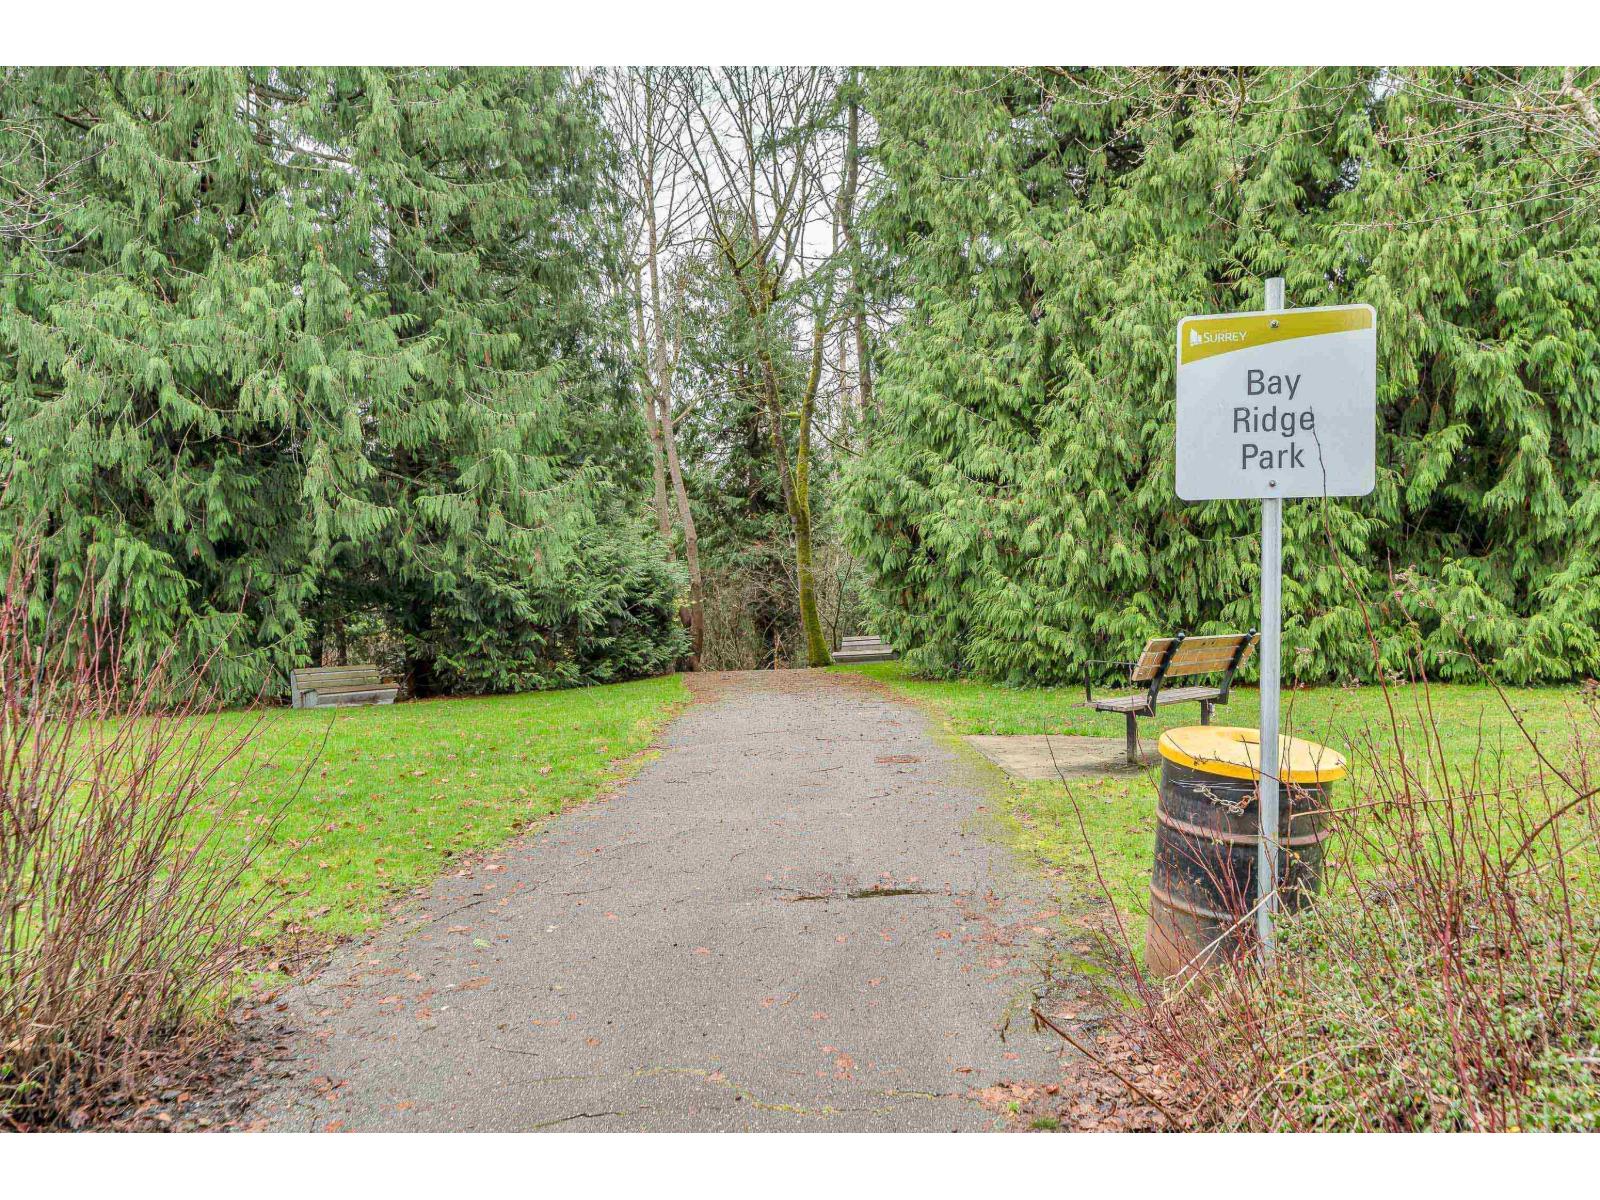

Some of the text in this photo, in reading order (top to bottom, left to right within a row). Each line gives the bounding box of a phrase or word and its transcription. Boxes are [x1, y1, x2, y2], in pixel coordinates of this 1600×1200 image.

[1247, 369, 1301, 400] Bay
[1233, 405, 1315, 437] Ridge
[1241, 442, 1305, 470] Park
